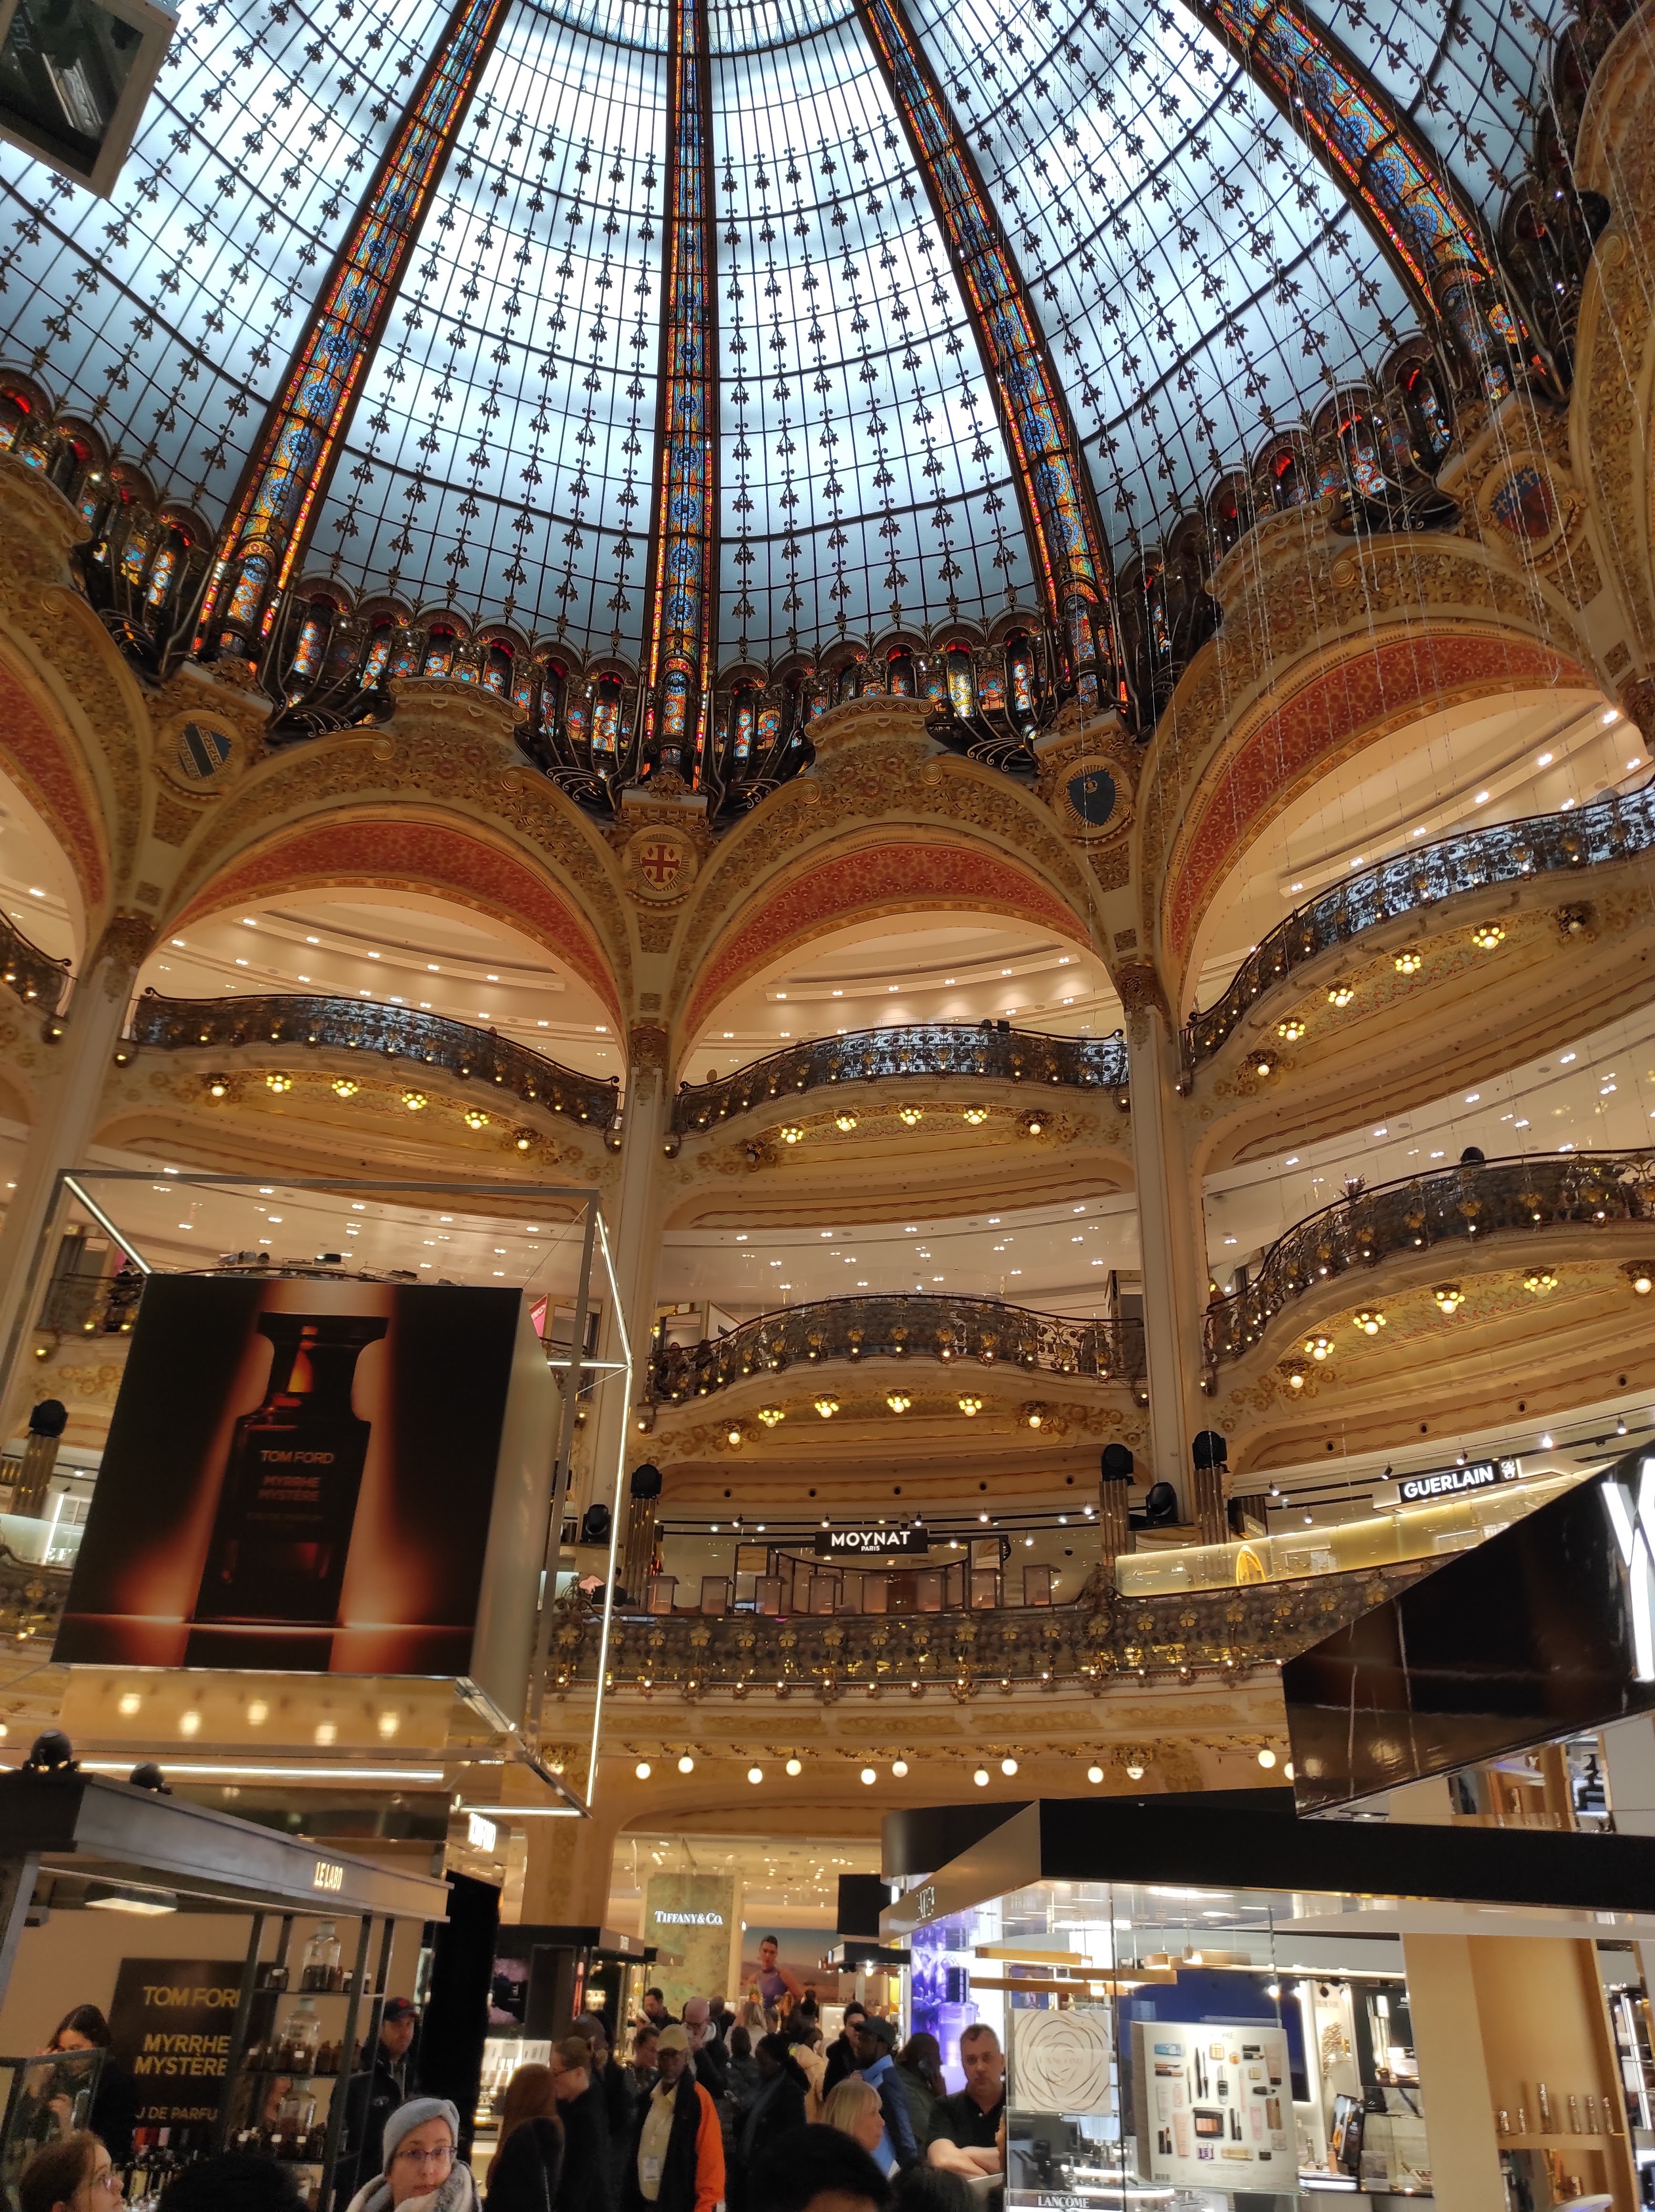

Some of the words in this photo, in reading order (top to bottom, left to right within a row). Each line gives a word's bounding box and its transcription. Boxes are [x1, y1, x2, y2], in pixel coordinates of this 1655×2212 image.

[261, 1450, 294, 1463] TOM
[294, 1451, 334, 1464] FORD
[1404, 1465, 1494, 1498] GUERLAIN
[831, 1531, 910, 1546] MOYNAT
[314, 1861, 326, 1886] LE
[324, 1864, 343, 1890] LABO
[143, 1986, 190, 2006] TOM
[192, 1987, 241, 2007] FOR
[143, 2033, 232, 2053] MYRRHE
[171, 2107, 217, 2121] PARFU
